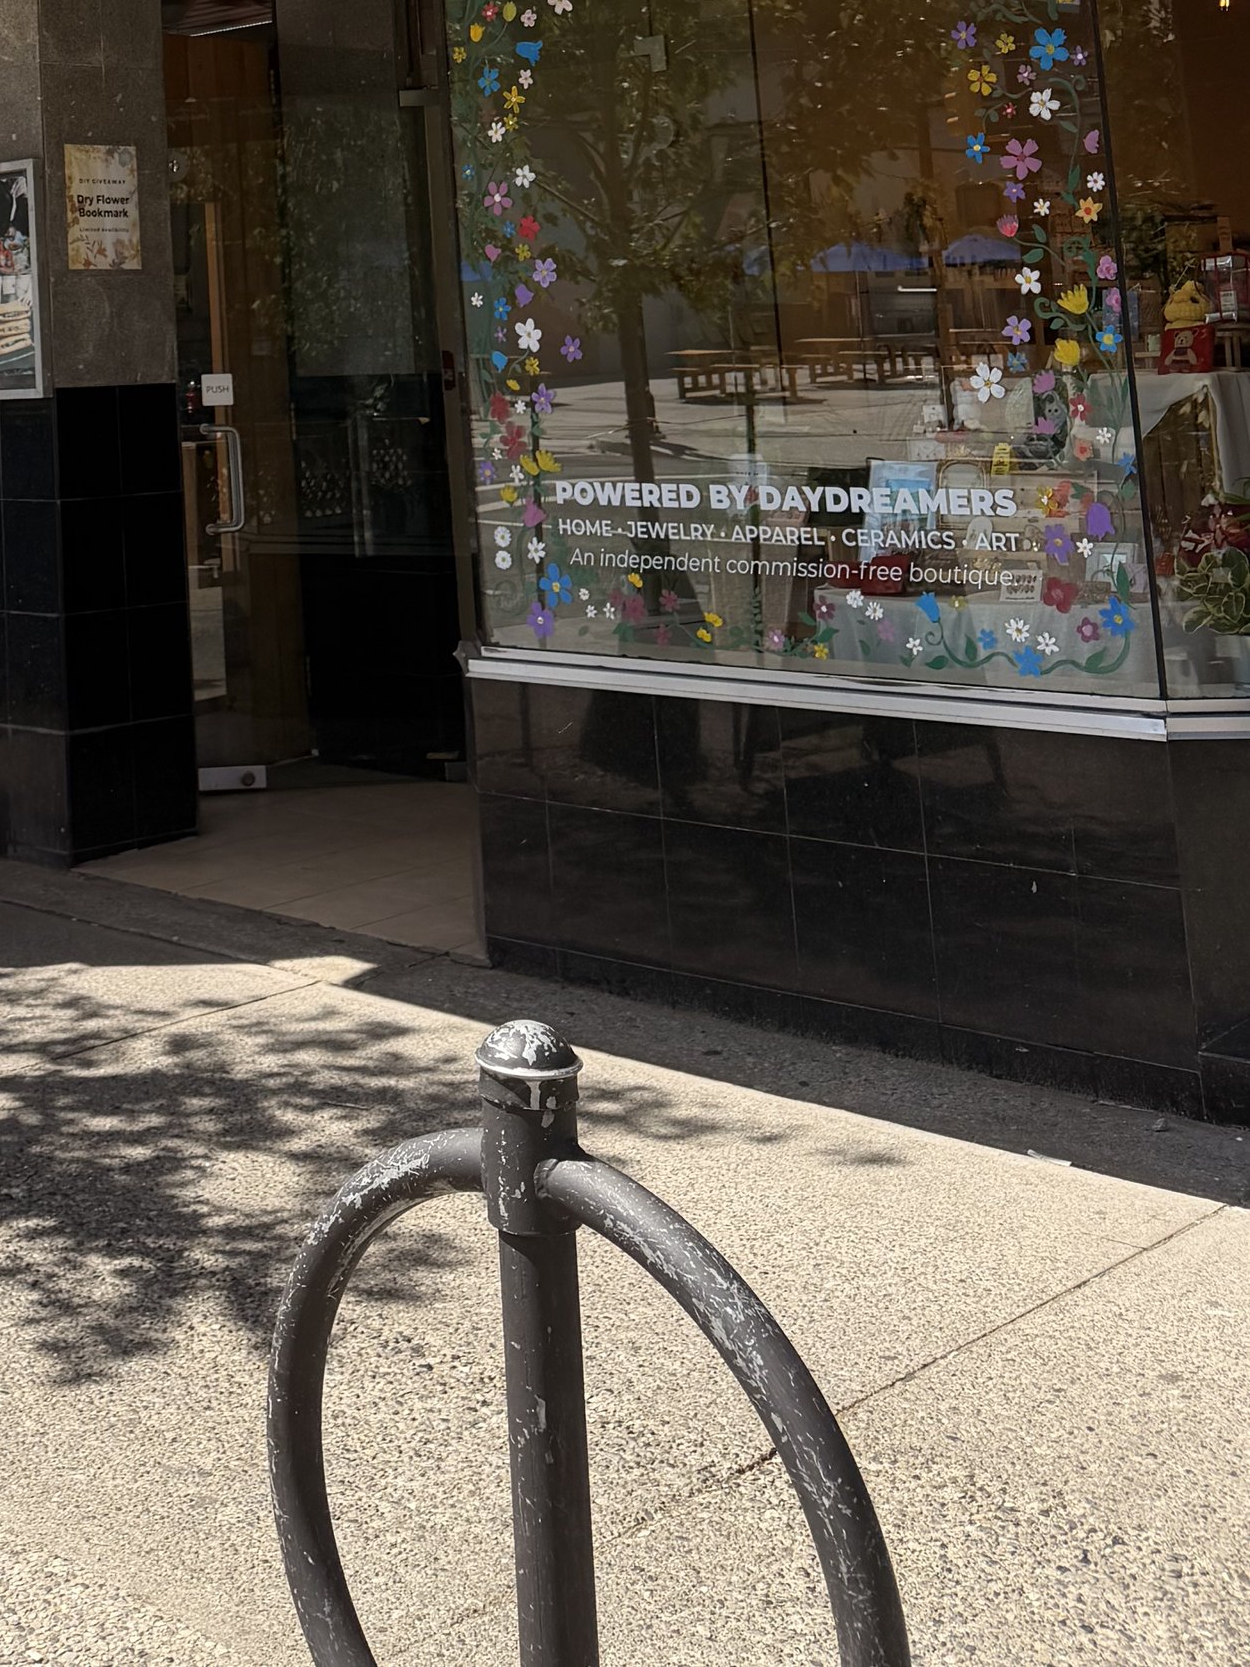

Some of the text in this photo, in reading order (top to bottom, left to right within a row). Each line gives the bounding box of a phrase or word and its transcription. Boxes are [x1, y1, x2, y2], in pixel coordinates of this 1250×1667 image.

[77, 195, 130, 206] Dry Flower
[79, 208, 129, 218] Bookmark
[206, 385, 229, 394] PUSH
[555, 481, 1018, 517] POWERED BY DAYDREAMERS
[558, 518, 1020, 552] HOME JEWELRY APPAREL CERAMICS ART
[570, 548, 1018, 589] An independent commission-free boutique.
